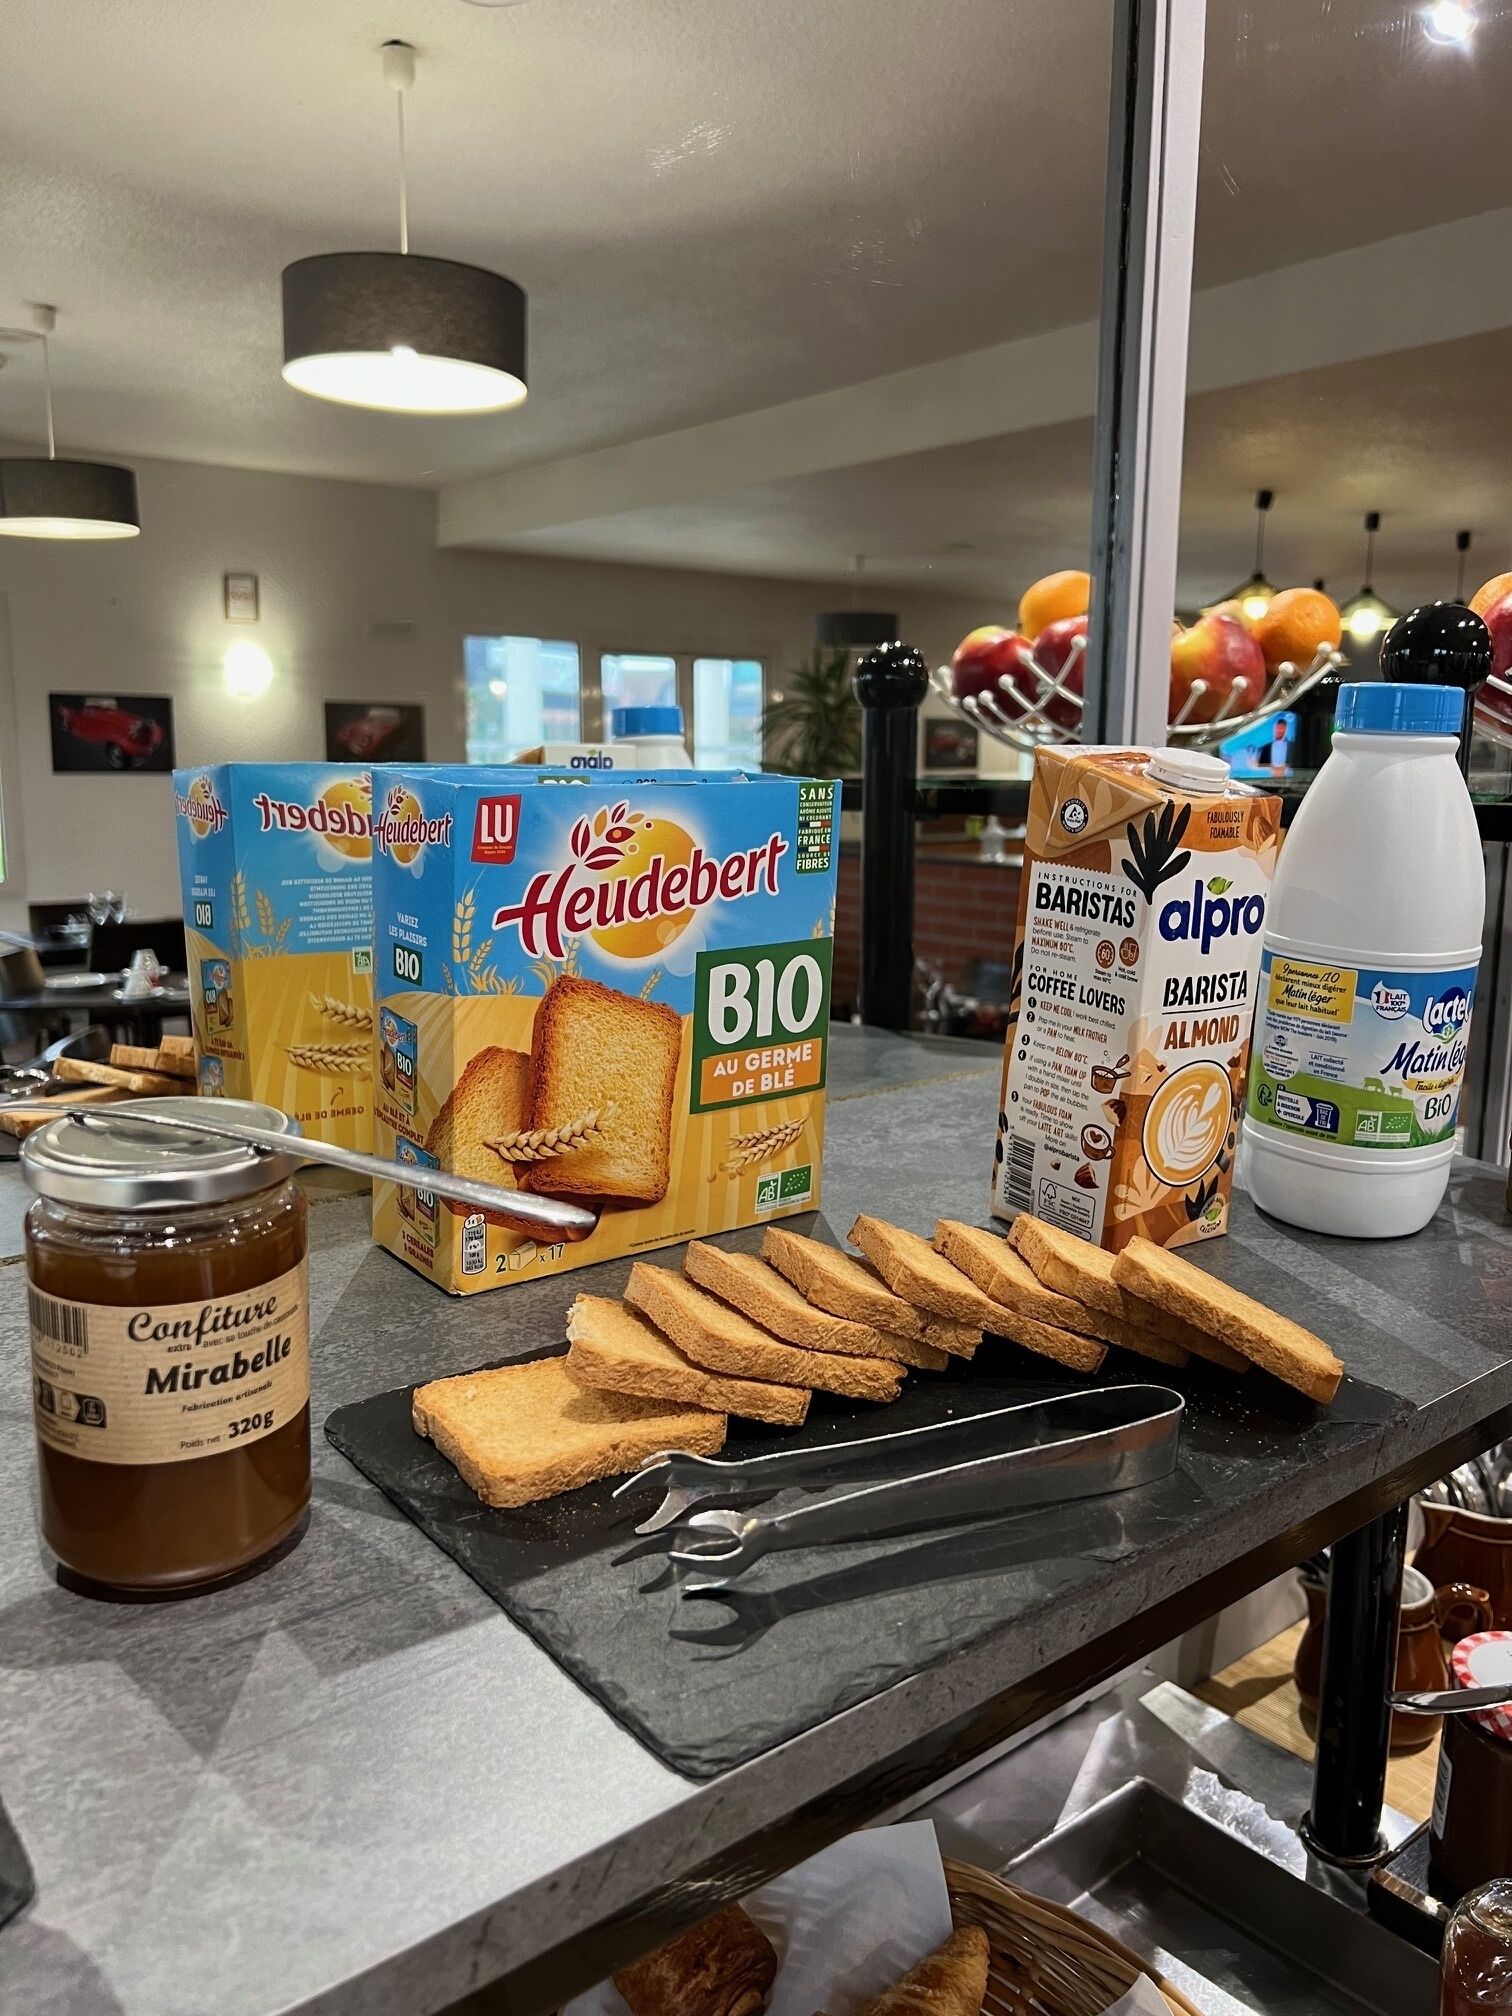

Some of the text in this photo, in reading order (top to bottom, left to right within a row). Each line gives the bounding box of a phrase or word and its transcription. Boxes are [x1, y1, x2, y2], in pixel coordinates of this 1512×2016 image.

[800, 787, 833, 800] SANS
[481, 804, 513, 843] LU
[1207, 811, 1244, 824] FABULOUSLY
[374, 812, 452, 854] Heudebert
[797, 834, 830, 845] FRANCE
[1210, 826, 1240, 839] FOAMABLE
[796, 857, 829, 870] FIBRES
[494, 833, 788, 957] Heudebert
[1038, 872, 1137, 897] INSTRUCTIONS FOR
[1036, 882, 1136, 928] BARISTAS
[397, 912, 419, 929] VARIEZ
[1034, 917, 1101, 937] SHAKE WELL refrigerate
[1158, 880, 1265, 954] alpro
[388, 924, 427, 948] LES PLAISIRS
[1031, 936, 1058, 950] MAXIMUM
[1033, 927, 1052, 936] before
[1066, 933, 1082, 942] Steam
[395, 947, 420, 981] BIO
[1030, 964, 1078, 981] FOR HOME
[1282, 963, 1340, 983] 9 personnes /10
[1028, 973, 1125, 1016] COFFEE LOVERS
[1163, 970, 1247, 1007] BARISTA
[1275, 973, 1347, 994] déclarent mieux digérer
[1281, 984, 1307, 1000] Matin
[708, 954, 823, 1045] BIO
[1275, 998, 1308, 1011] que leur lait
[1040, 1001, 1052, 1011] KEEP
[1053, 1004, 1060, 1014] ME
[1060, 1005, 1072, 1018] COOL
[1075, 1012, 1087, 1020] work
[1089, 1016, 1099, 1025] best
[1422, 990, 1472, 1033] lactel
[1038, 1015, 1048, 1024] Pop
[1061, 1024, 1072, 1033] your
[1073, 1026, 1085, 1037] MILK
[1086, 1029, 1108, 1044] FROTHER
[1046, 1027, 1057, 1038] PAN
[1163, 1015, 1240, 1050] ALMOND
[713, 1043, 812, 1077] AU GERME
[1033, 1040, 1046, 1049] Keep
[1055, 1046, 1073, 1059] BELOW
[1379, 1041, 1446, 1081] Matin
[397, 1052, 412, 1077] BIO
[1042, 1069, 1055, 1079] hand
[1056, 1074, 1070, 1083] mixer
[1064, 1065, 1078, 1078] FOAM
[1078, 1070, 1087, 1080] UP
[732, 1063, 794, 1097] DE BLÉ
[1023, 1083, 1033, 1091] pan
[1040, 1088, 1050, 1097] POP
[1028, 1074, 1044, 1085] double
[1061, 1085, 1071, 1094] then
[1022, 1096, 1073, 1121] Your FABULOUS FOAM
[1026, 1118, 1037, 1126] your
[1037, 1121, 1052, 1134] LATTE
[1052, 1126, 1064, 1138] ART
[1040, 1112, 1052, 1120] Time
[1059, 1119, 1073, 1130] show
[398, 1123, 424, 1145] COMPLET
[1045, 1134, 1058, 1144] More
[1043, 1143, 1080, 1162] @alprobarista
[758, 1181, 777, 1202] AB
[496, 1244, 564, 1273] 2 x 17
[128, 1295, 278, 1345] Confiture
[167, 1342, 192, 1353] extra
[202, 1338, 224, 1349] avec
[225, 1334, 236, 1344] sa
[237, 1326, 263, 1340] touche
[144, 1334, 292, 1395] Mirabelle
[182, 1380, 273, 1413] Fabrication artisanale
[180, 1409, 275, 1450] Poids net 320g
